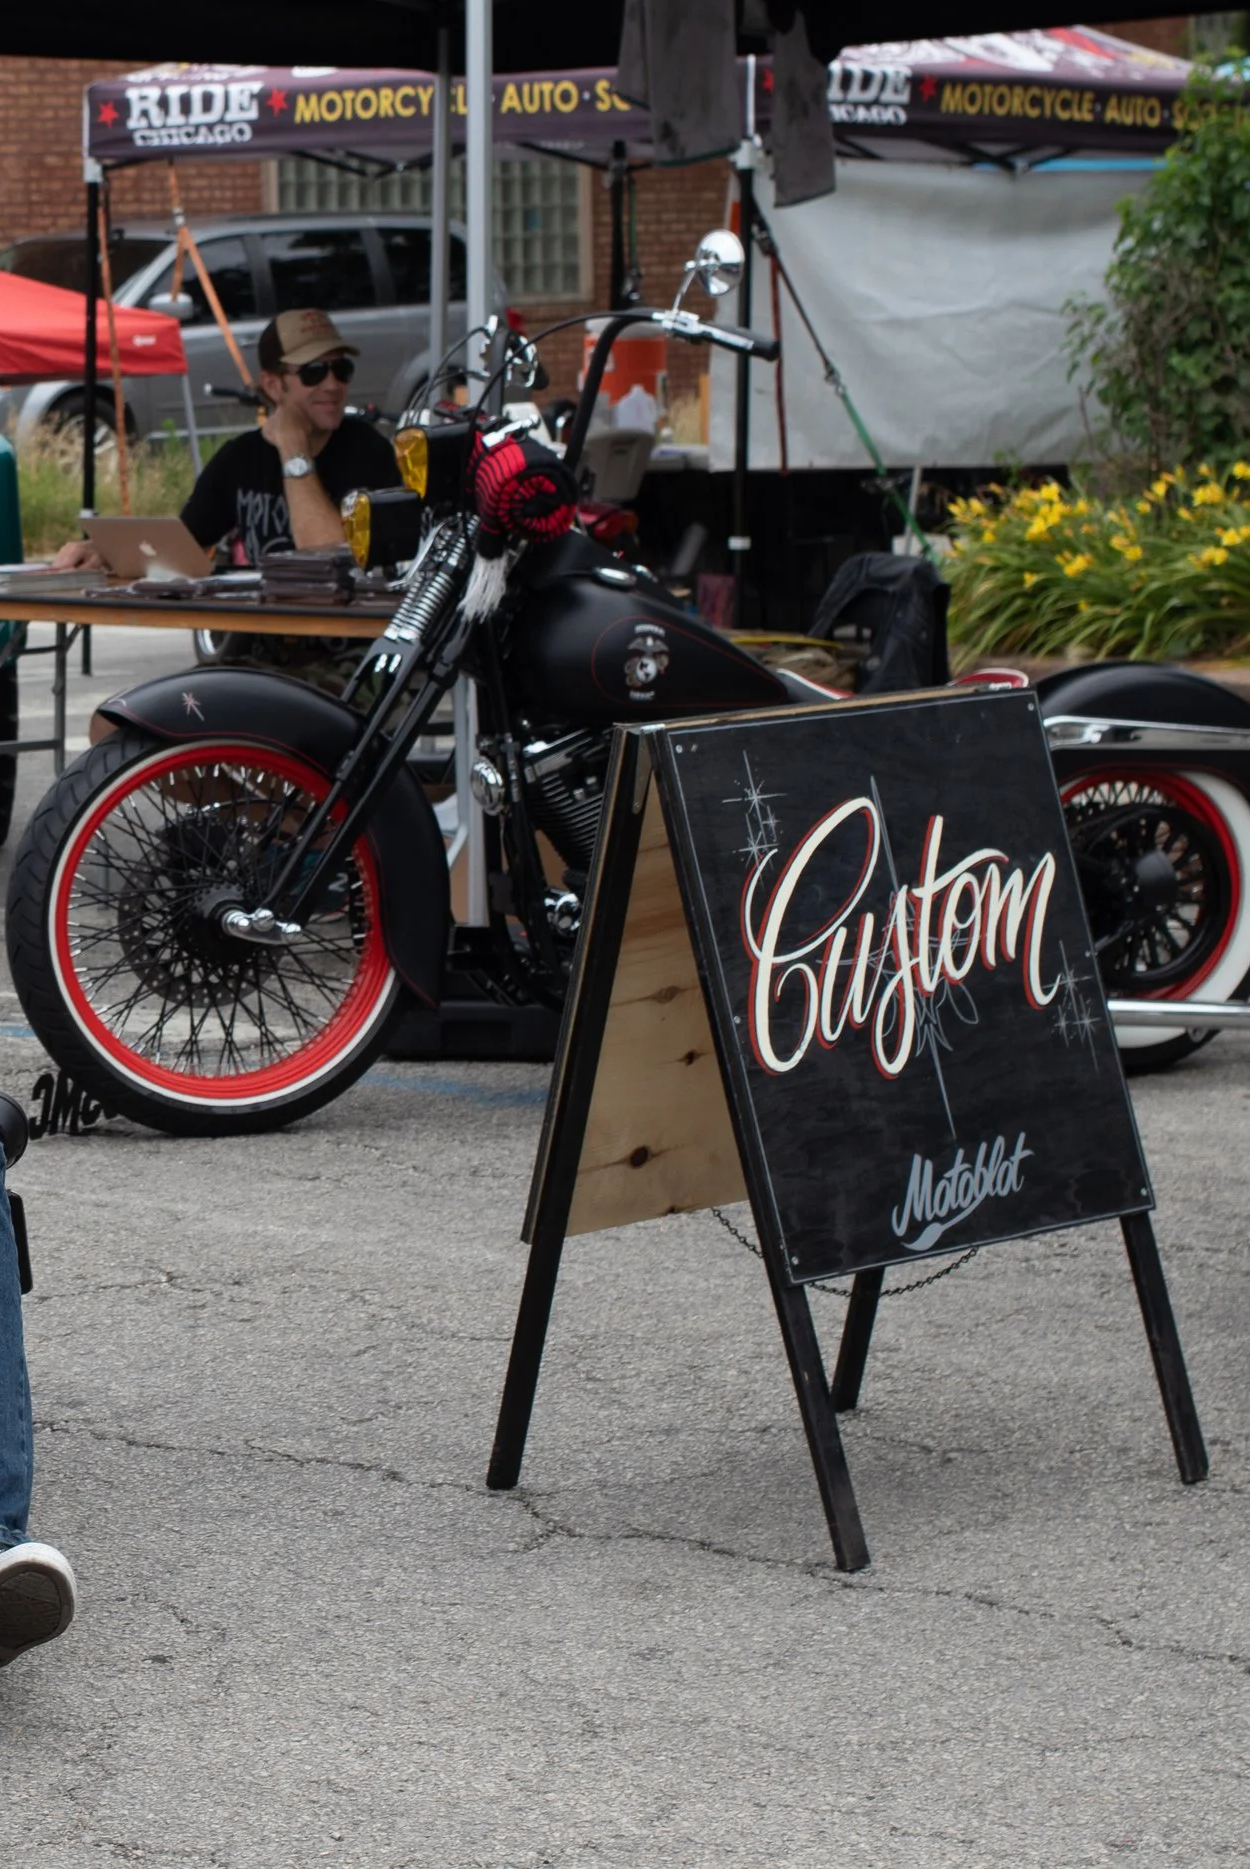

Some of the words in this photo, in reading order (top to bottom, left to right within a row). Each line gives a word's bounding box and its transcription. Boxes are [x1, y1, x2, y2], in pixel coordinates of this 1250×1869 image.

[125, 81, 264, 130] RIDE
[500, 80, 580, 114] AUTO
[828, 60, 913, 104] IDE
[940, 82, 1095, 121] MOTORCYCLE
[1104, 95, 1161, 127] AUTO
[133, 122, 253, 147] CHICAGO
[740, 796, 1062, 1081] Custom
[891, 1131, 1035, 1237] Motoblot
